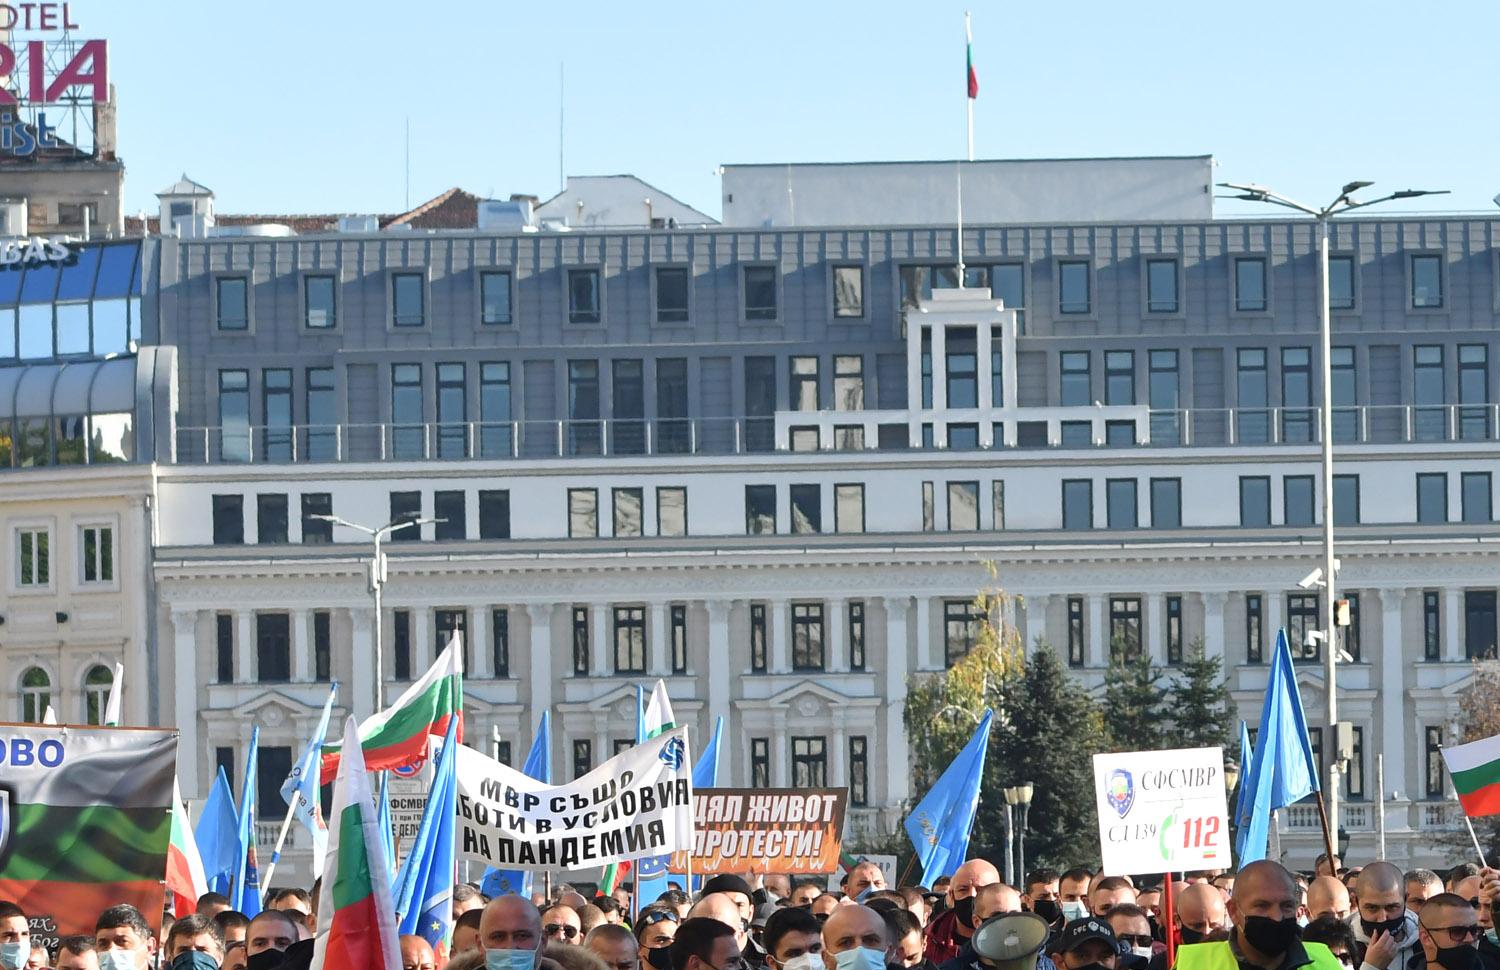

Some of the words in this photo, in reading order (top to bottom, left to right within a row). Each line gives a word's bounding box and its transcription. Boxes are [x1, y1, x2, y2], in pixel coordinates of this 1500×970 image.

[0, 738, 64, 767] ВО
[1142, 766, 1216, 791] СФСМВР
[480, 777, 540, 812] МВР
[536, 818, 552, 835] В
[562, 778, 689, 831] УСЛОВИЯ
[747, 794, 837, 823] ЖИВОТ
[464, 826, 491, 860] НА
[499, 819, 665, 867] ПАНДЕМИЯ
[694, 830, 823, 858] ПРОТЕСТИ!
[1183, 816, 1220, 849] 112
